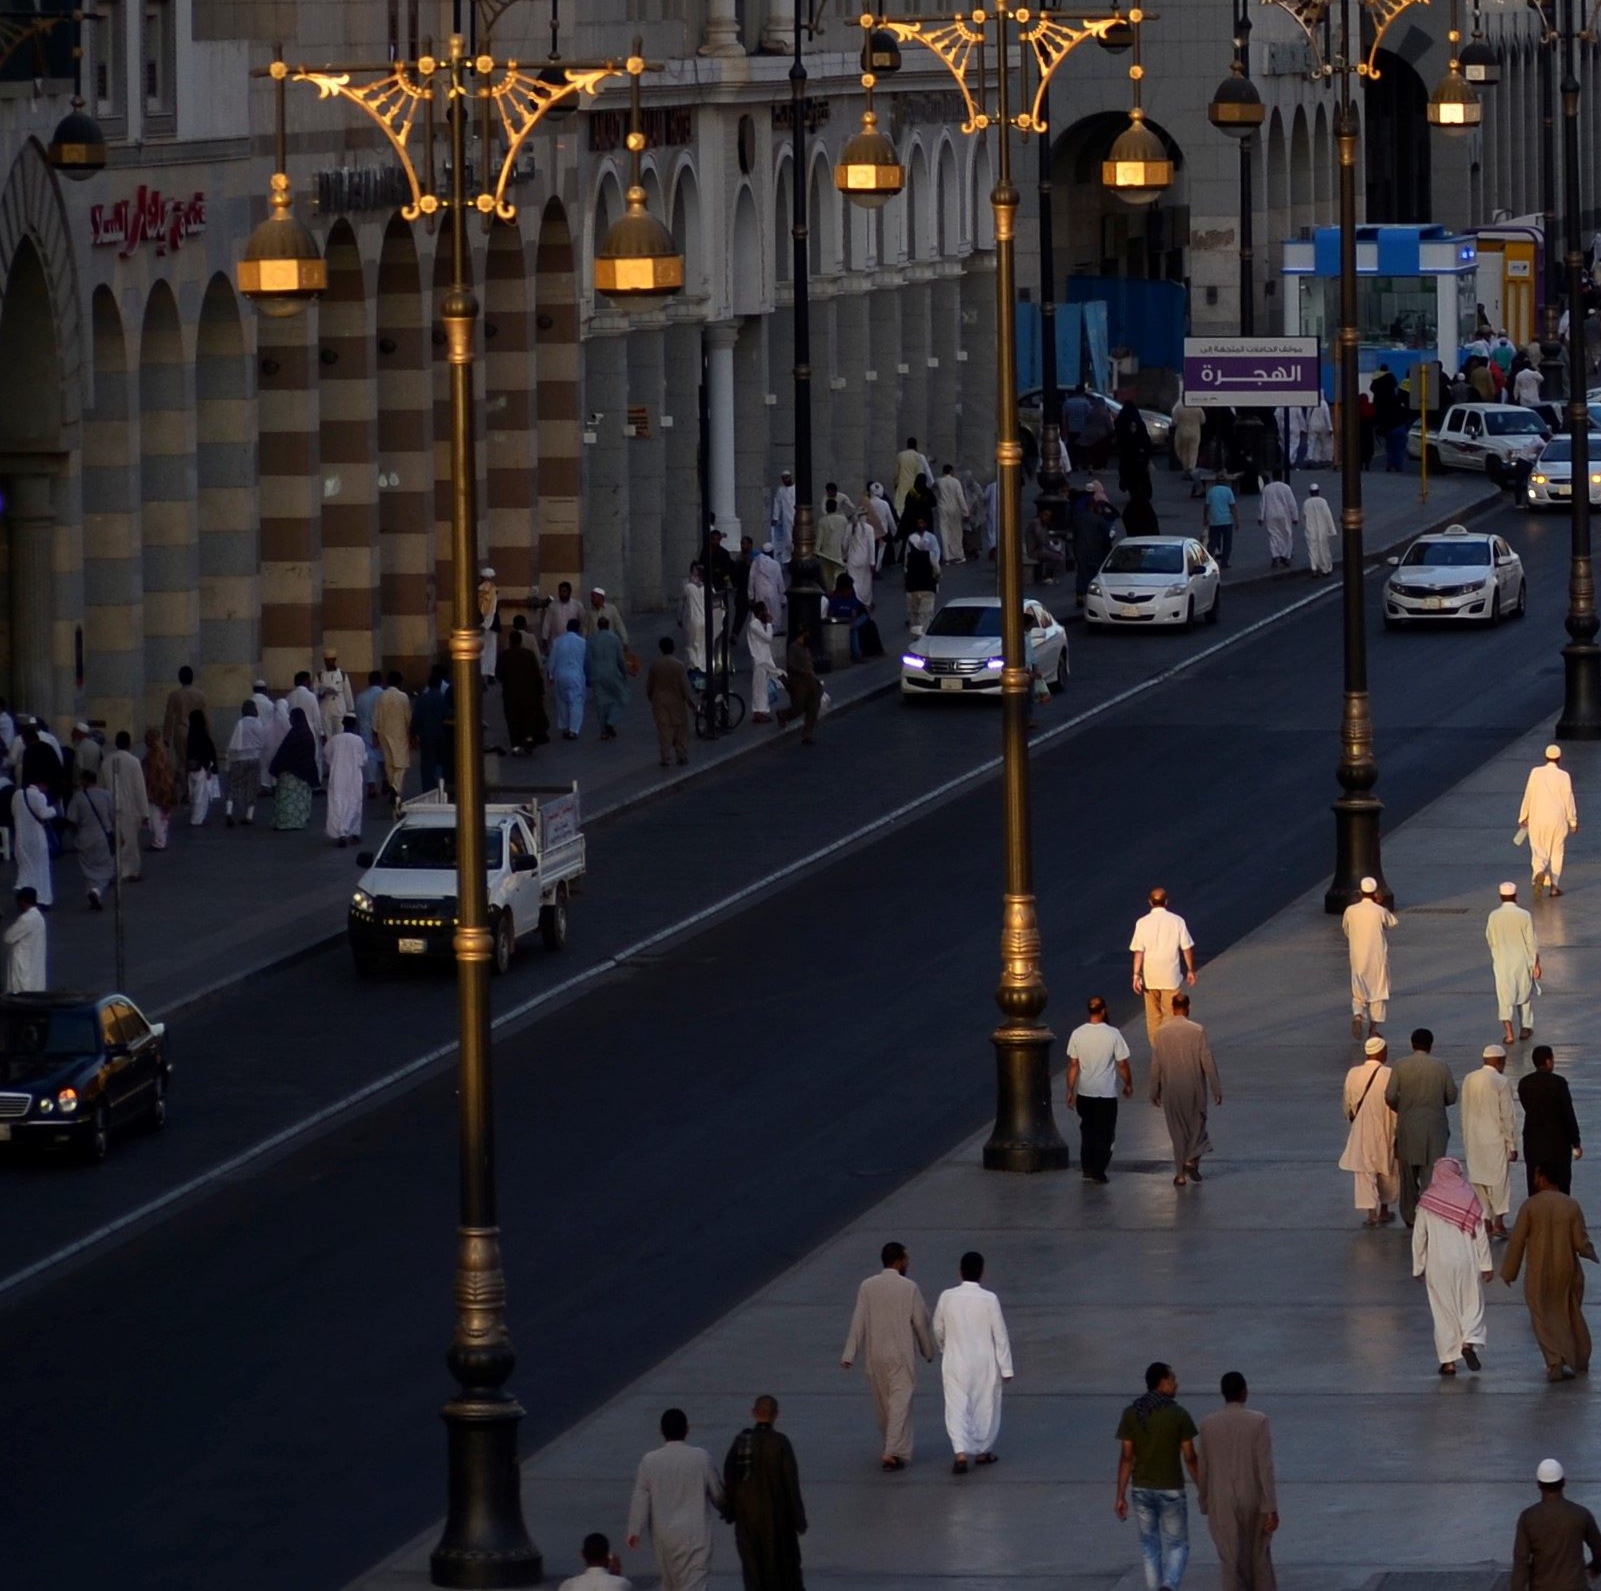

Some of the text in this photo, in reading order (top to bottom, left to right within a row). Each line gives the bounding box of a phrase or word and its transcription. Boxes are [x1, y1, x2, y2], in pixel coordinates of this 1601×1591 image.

[1215, 345, 1245, 354] المتجهة
[1278, 345, 1303, 354] موقف
[1201, 364, 1301, 386] الهجرة
